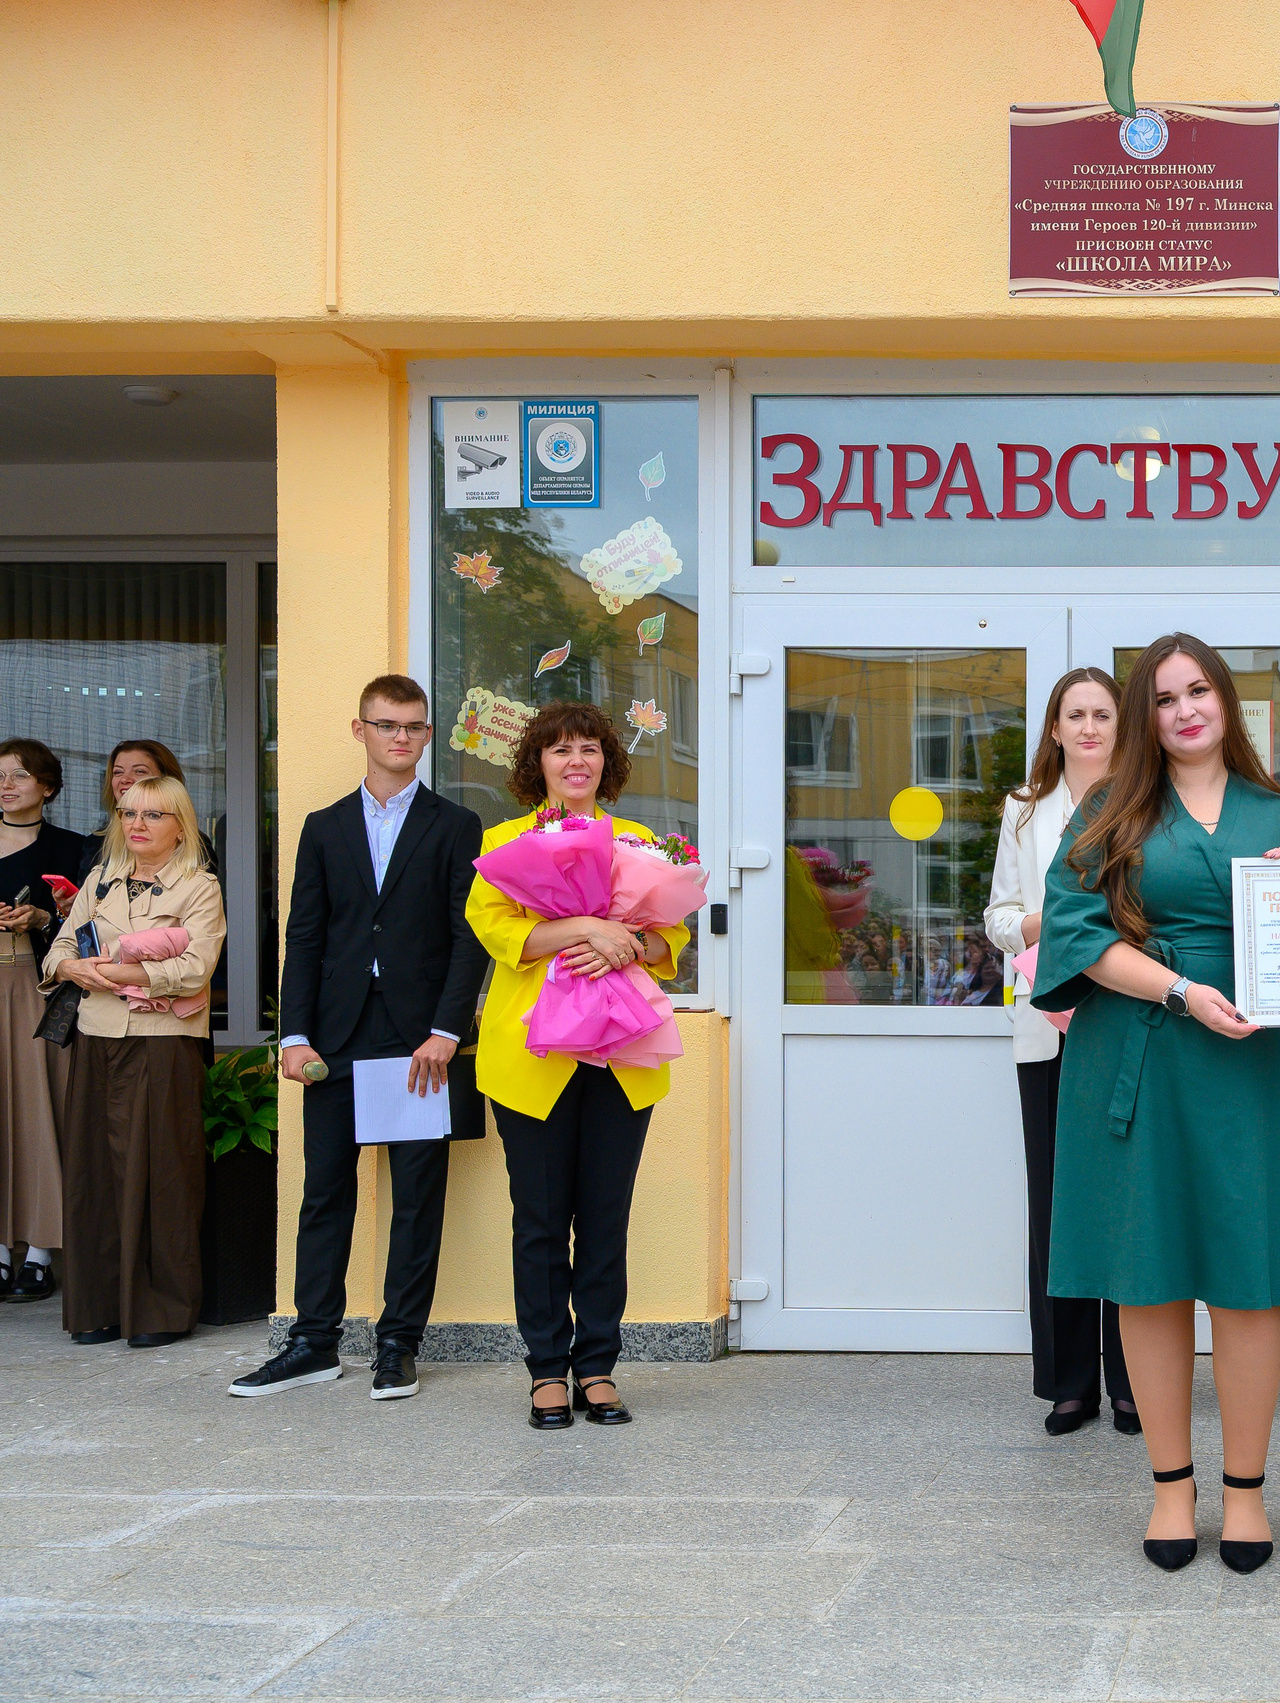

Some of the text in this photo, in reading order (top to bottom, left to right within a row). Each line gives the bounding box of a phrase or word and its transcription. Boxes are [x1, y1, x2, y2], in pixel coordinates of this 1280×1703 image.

[1073, 164, 1216, 176] ГОСУДАРСТВЕННОМУ
[1044, 179, 1243, 191] УЧРЕЖДЕНИЮ ОБРАЗОВАНИЯ
[1014, 197, 1273, 214] «Средняя школа № 197 г. Минска
[1030, 218, 1257, 234] имени Героев 120-й дивизии»
[1075, 240, 1213, 251] ПРИСВОЕН СТАТУС
[1056, 255, 1232, 272] «ШКОЛА МИРА»
[527, 405, 595, 416] МИЛИЦИЯ
[454, 434, 510, 443] ВНИМАНИЕ
[605, 533, 636, 557] Буду
[492, 702, 516, 717] уже
[478, 724, 519, 746] канику
